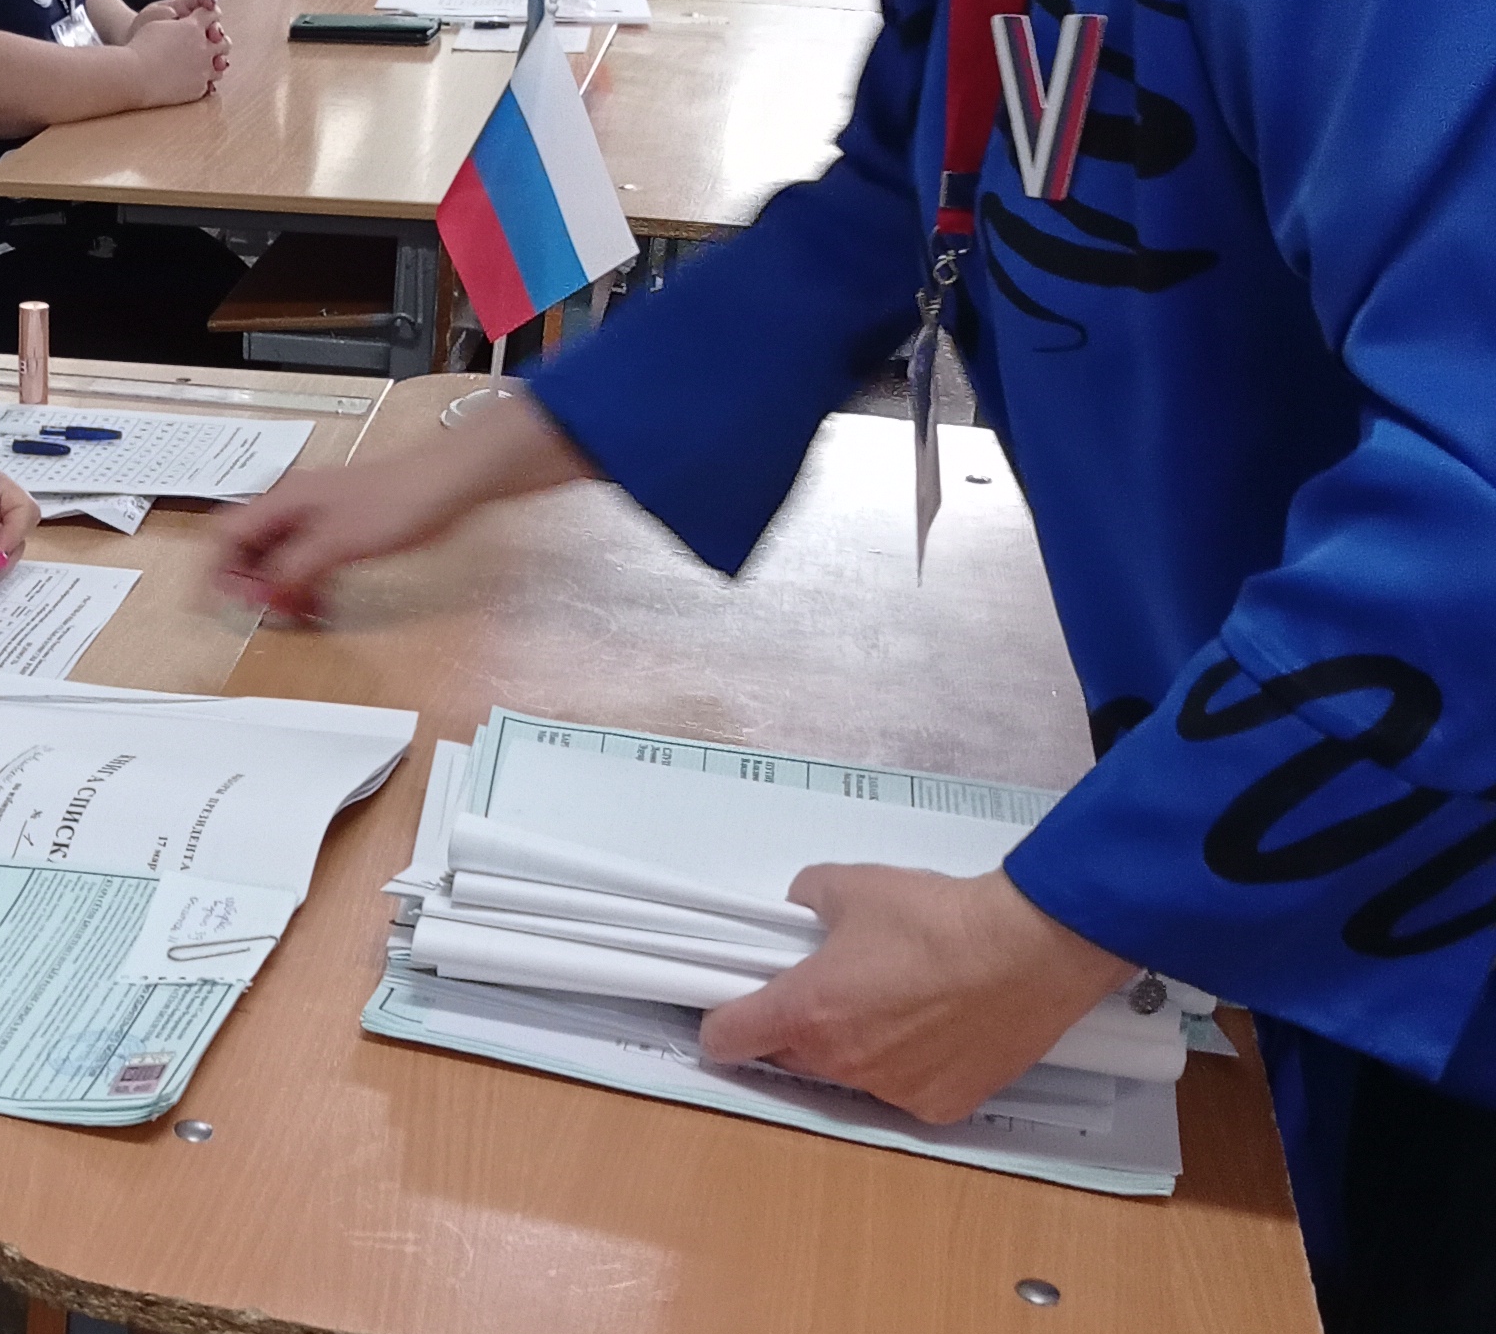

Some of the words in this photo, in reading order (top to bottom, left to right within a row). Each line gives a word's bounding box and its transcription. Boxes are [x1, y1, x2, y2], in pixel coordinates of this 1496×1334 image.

[86, 754, 136, 783] КНИГА
[46, 786, 97, 863] СПИСК
[180, 797, 219, 871] ПРЕЗИДЕНТА
[157, 836, 168, 848] 17
[147, 849, 161, 872] мар
